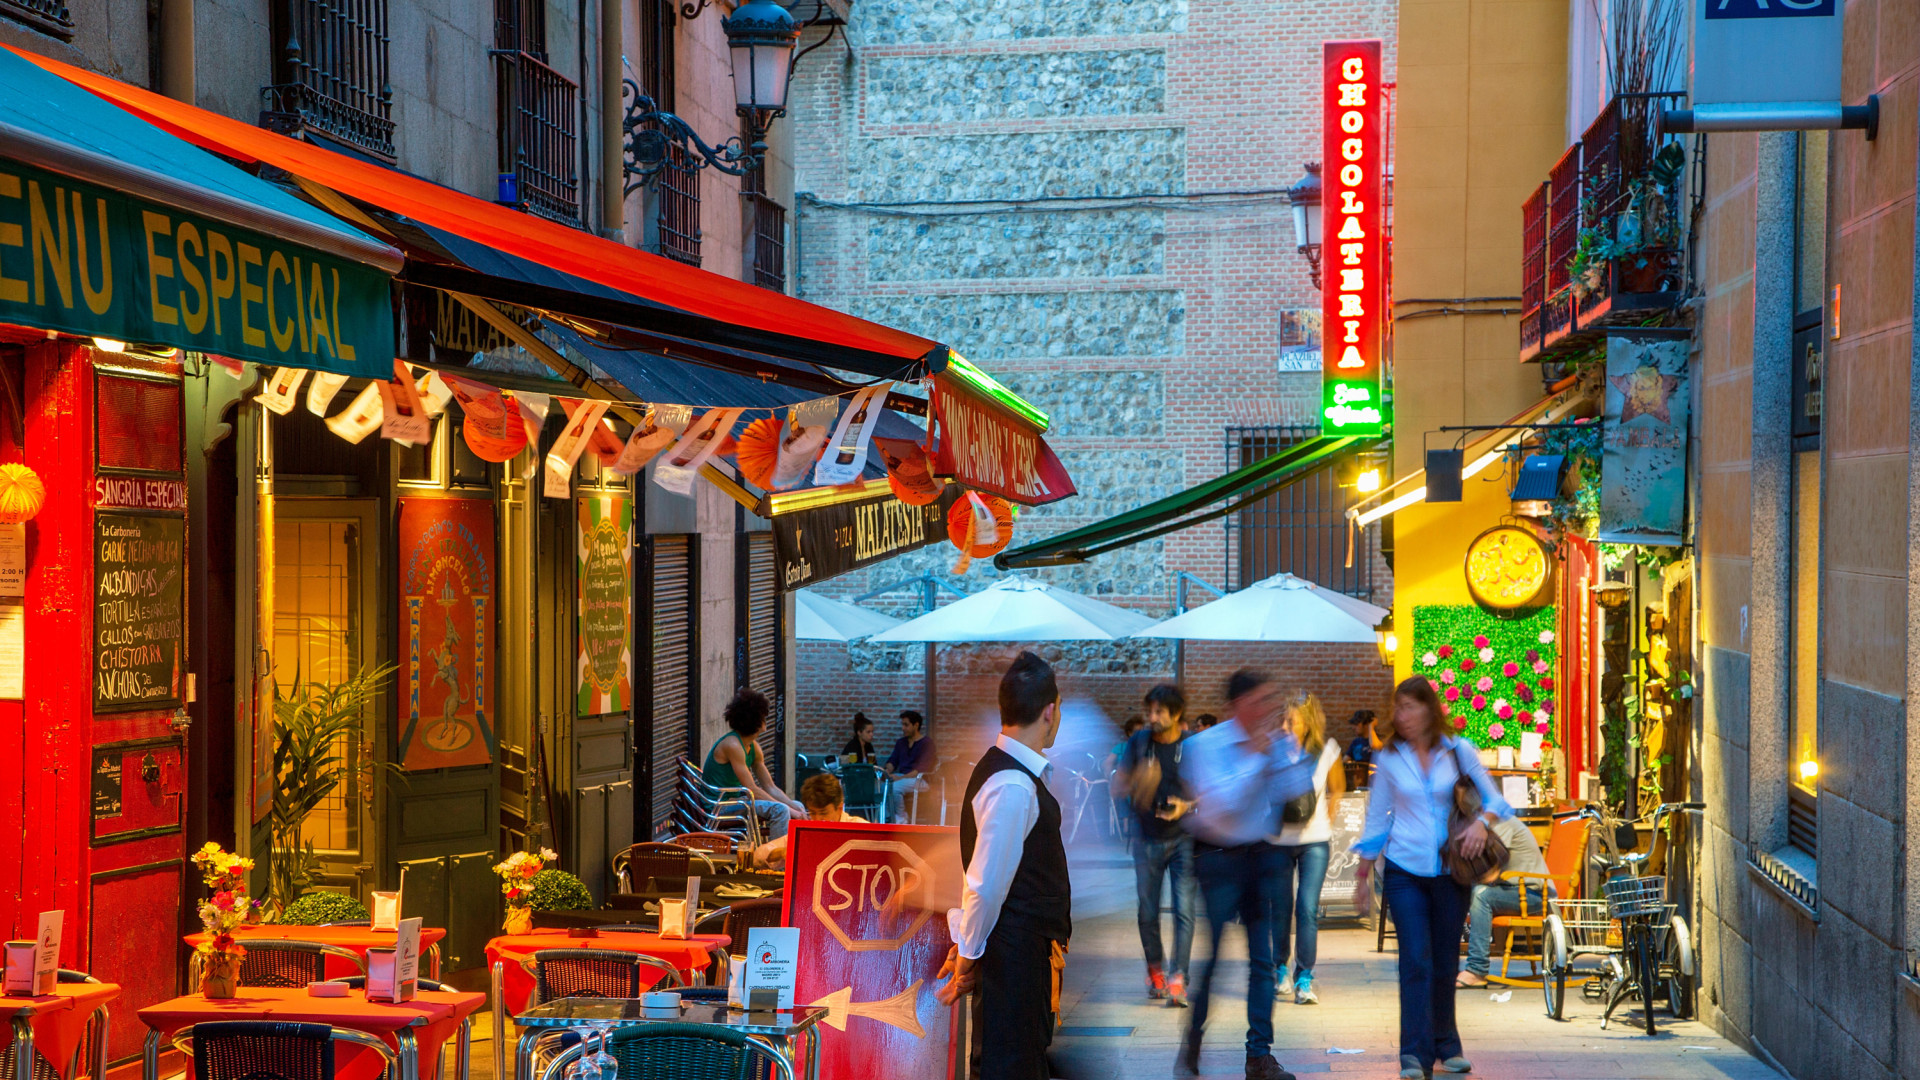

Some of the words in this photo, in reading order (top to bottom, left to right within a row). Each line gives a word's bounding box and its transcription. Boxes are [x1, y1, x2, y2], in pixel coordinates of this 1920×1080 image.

[1338, 58, 1366, 369] CHOCOLATERIA
[142, 210, 357, 362] ESPECIAL
[1284, 361, 1303, 370] SAN
[1310, 361, 1322, 370] GI
[96, 477, 143, 506] SANGRÍA
[145, 480, 186, 508] ESPECIAL
[102, 524, 110, 537] La
[110, 525, 141, 538] Carbonería
[855, 499, 925, 562] MALATESTA
[100, 566, 158, 598] ALBÓNDIGAS
[426, 555, 470, 596] LIMONCELLO
[439, 538, 480, 593] ITALIANI
[99, 597, 141, 625] TORTILLA
[100, 625, 134, 647] CALLOS
[410, 605, 419, 713] GRAPPA
[98, 668, 140, 700] ANCHOAS
[828, 861, 922, 913] STOP
